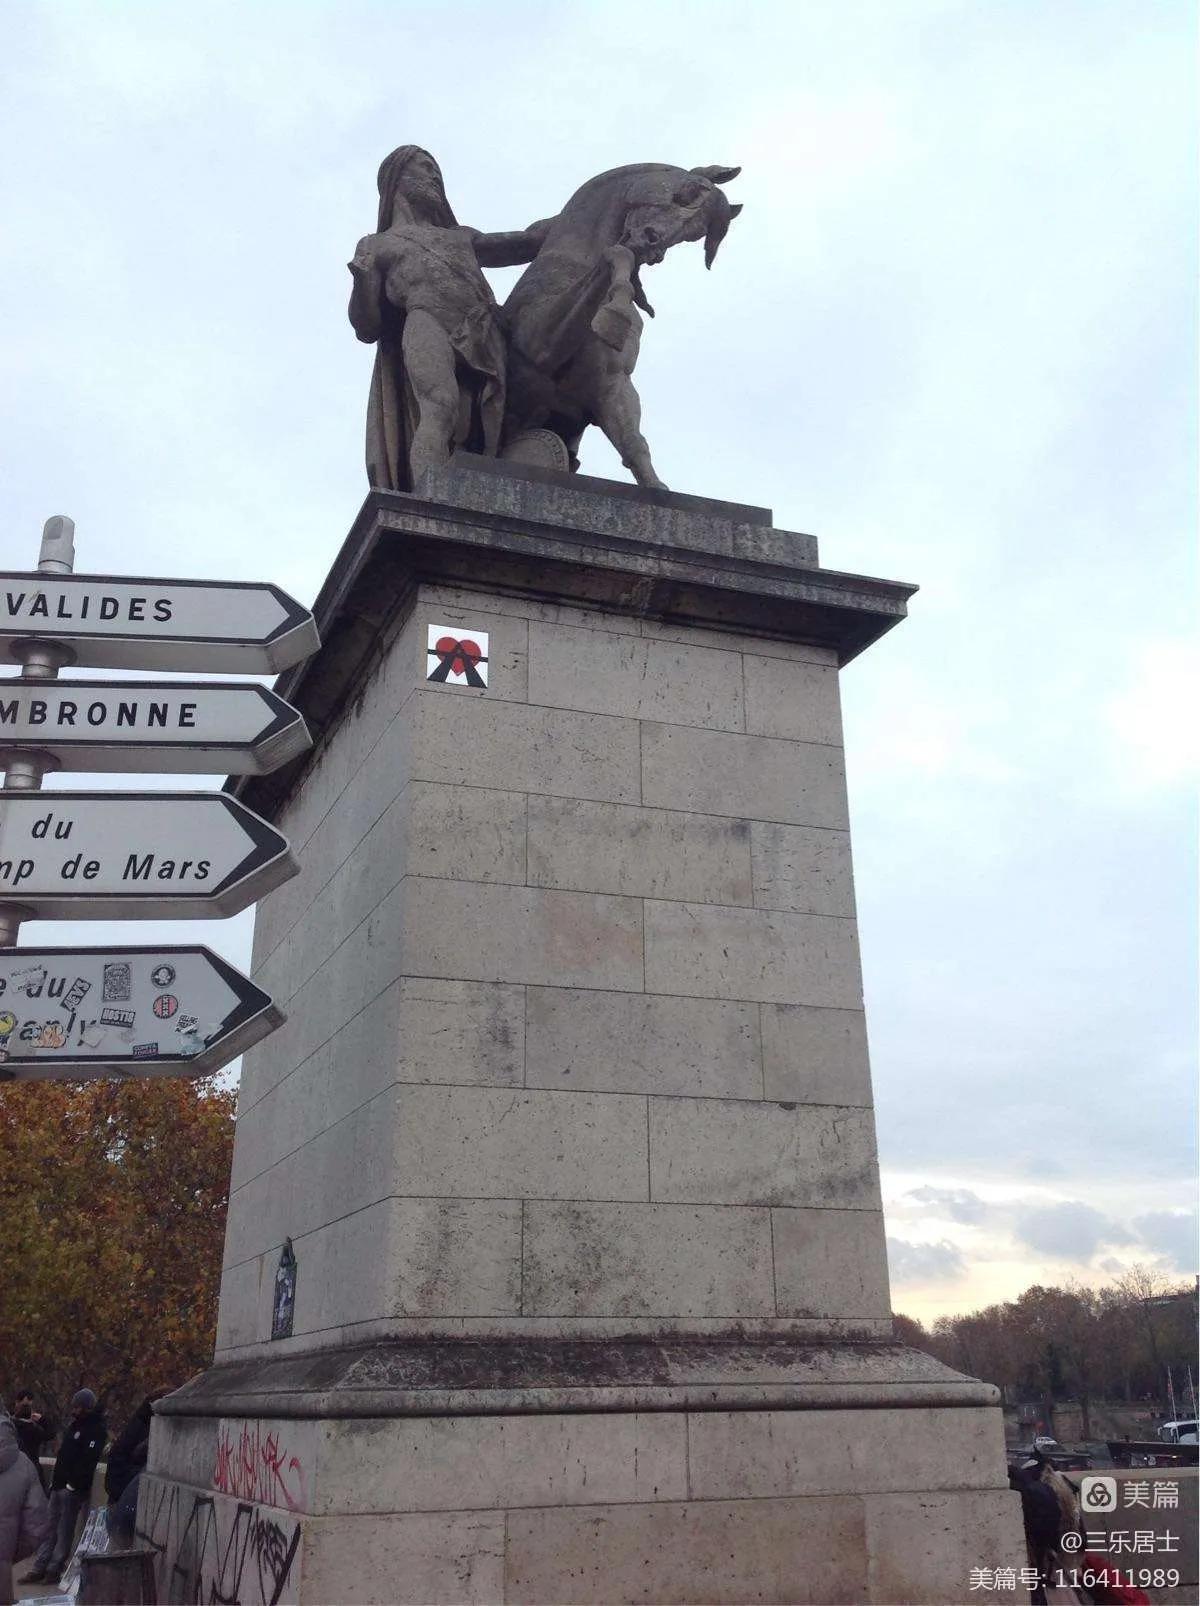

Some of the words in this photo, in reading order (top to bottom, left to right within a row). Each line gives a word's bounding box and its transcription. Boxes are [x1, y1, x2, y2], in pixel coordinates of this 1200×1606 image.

[6, 592, 174, 622] VALIDES
[0, 700, 197, 728] MBRONNE
[31, 813, 73, 840] du
[61, 854, 101, 880] de
[122, 854, 211, 880] Mars
